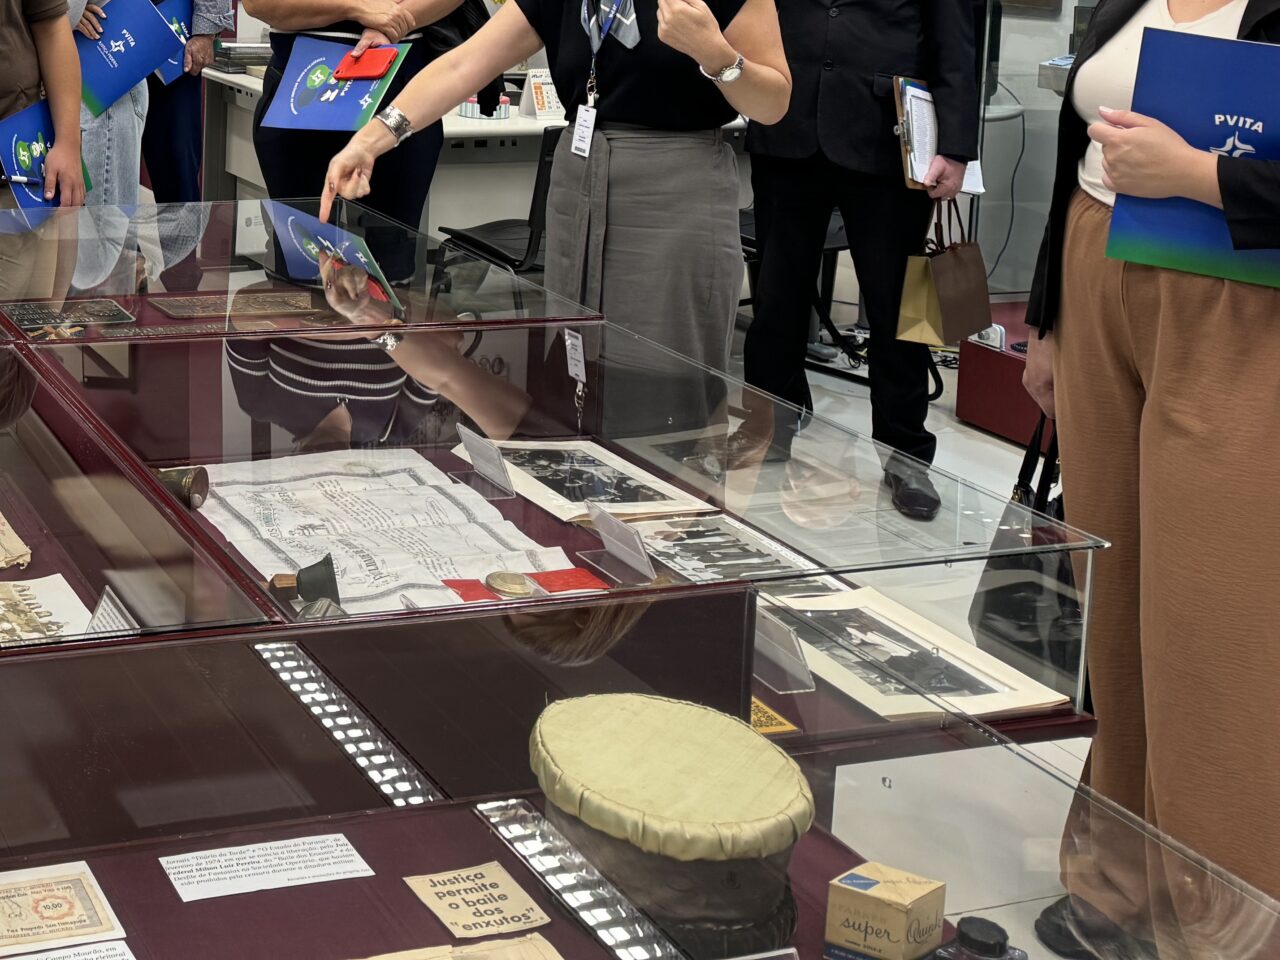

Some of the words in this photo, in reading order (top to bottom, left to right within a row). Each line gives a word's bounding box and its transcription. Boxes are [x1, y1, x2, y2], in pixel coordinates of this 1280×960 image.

[1214, 114, 1264, 134] PVITA
[430, 870, 485, 888] Justiça
[434, 881, 500, 901] permite
[43, 902, 63, 911] 10,00
[448, 900, 460, 910] o
[462, 892, 508, 908] baile
[472, 905, 504, 919] dos
[840, 918, 901, 944] super
